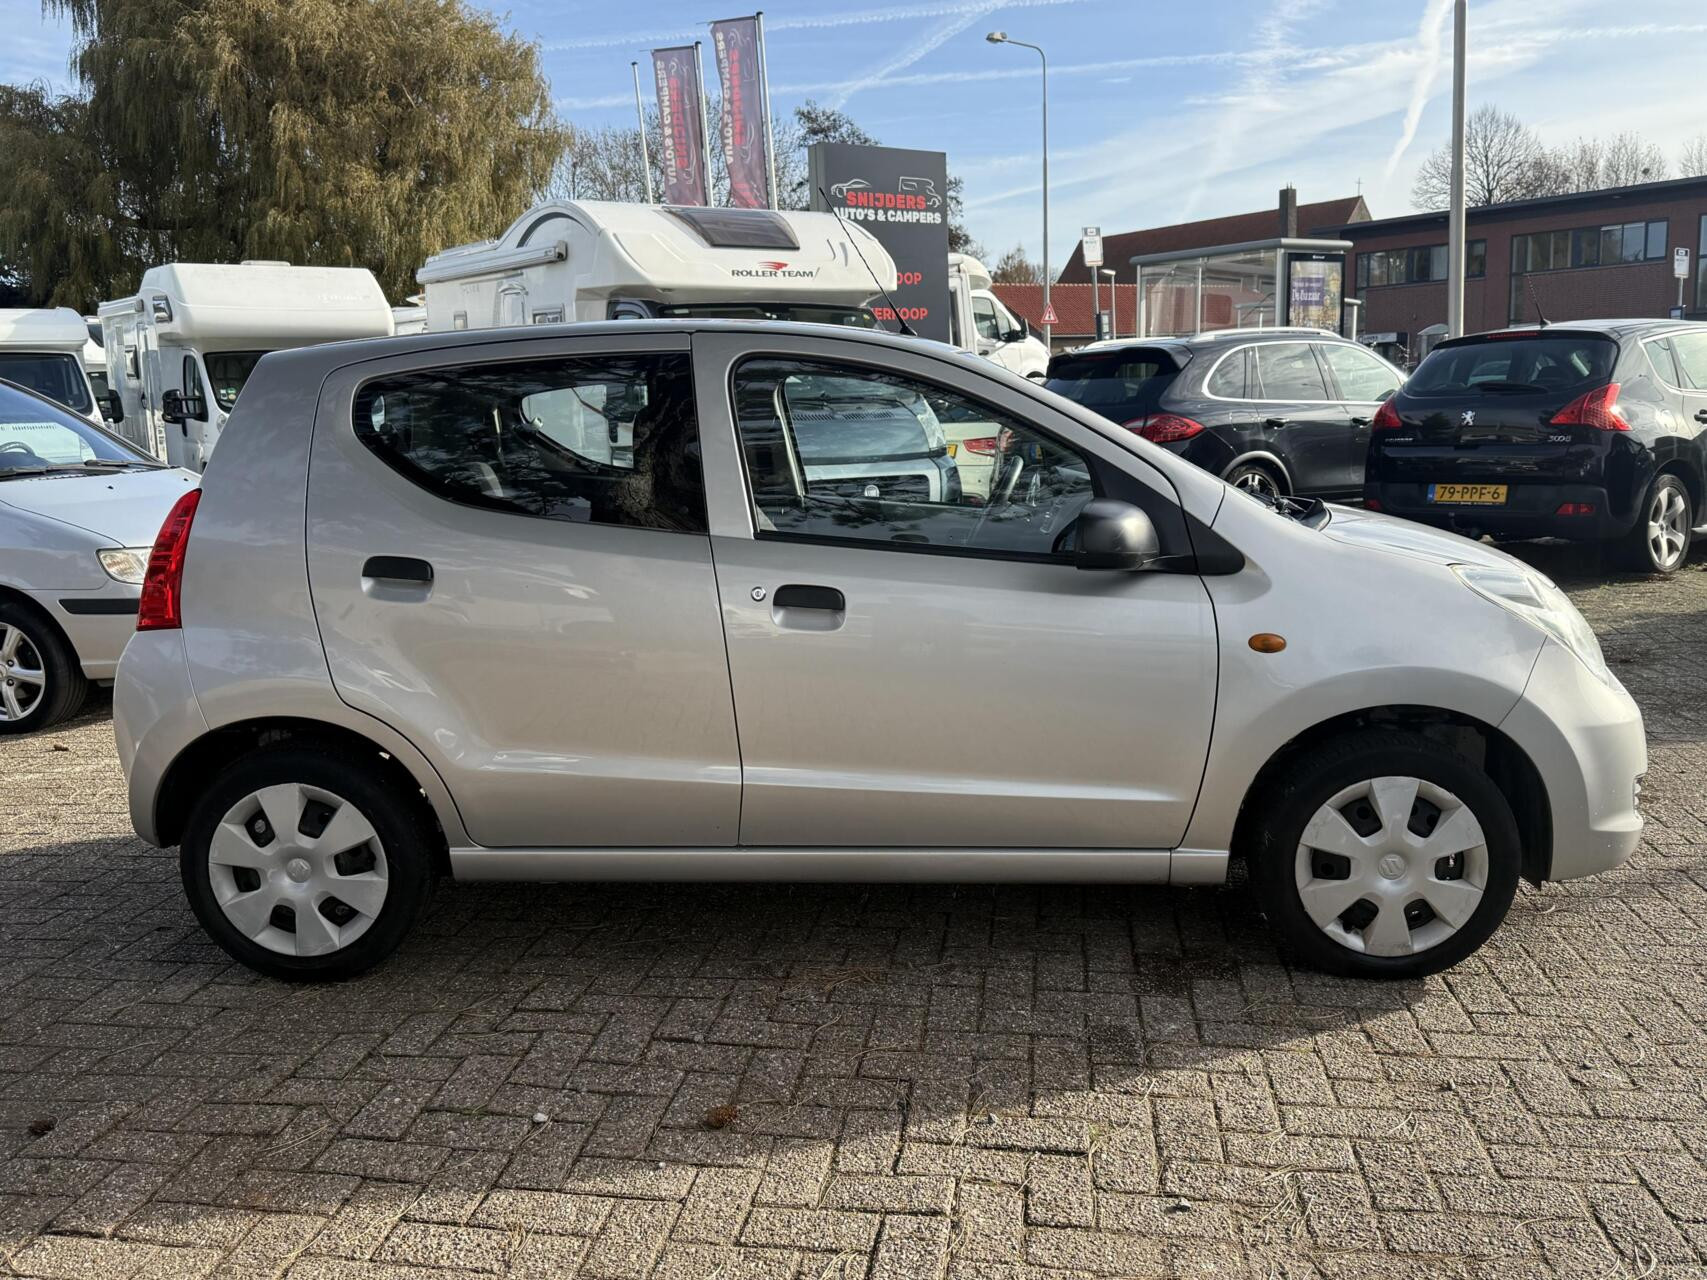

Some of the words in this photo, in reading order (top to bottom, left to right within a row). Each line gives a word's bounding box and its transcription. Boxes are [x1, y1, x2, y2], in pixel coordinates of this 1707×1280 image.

[846, 191, 926, 209] SNIJDERS
[834, 206, 875, 220] AUTO'S
[877, 209, 886, 222] &
[887, 210, 942, 224] CAMPERS
[731, 269, 777, 278] ROLLER
[896, 272, 922, 285] OOP
[1439, 486, 1500, 501] 79-PPF-6
